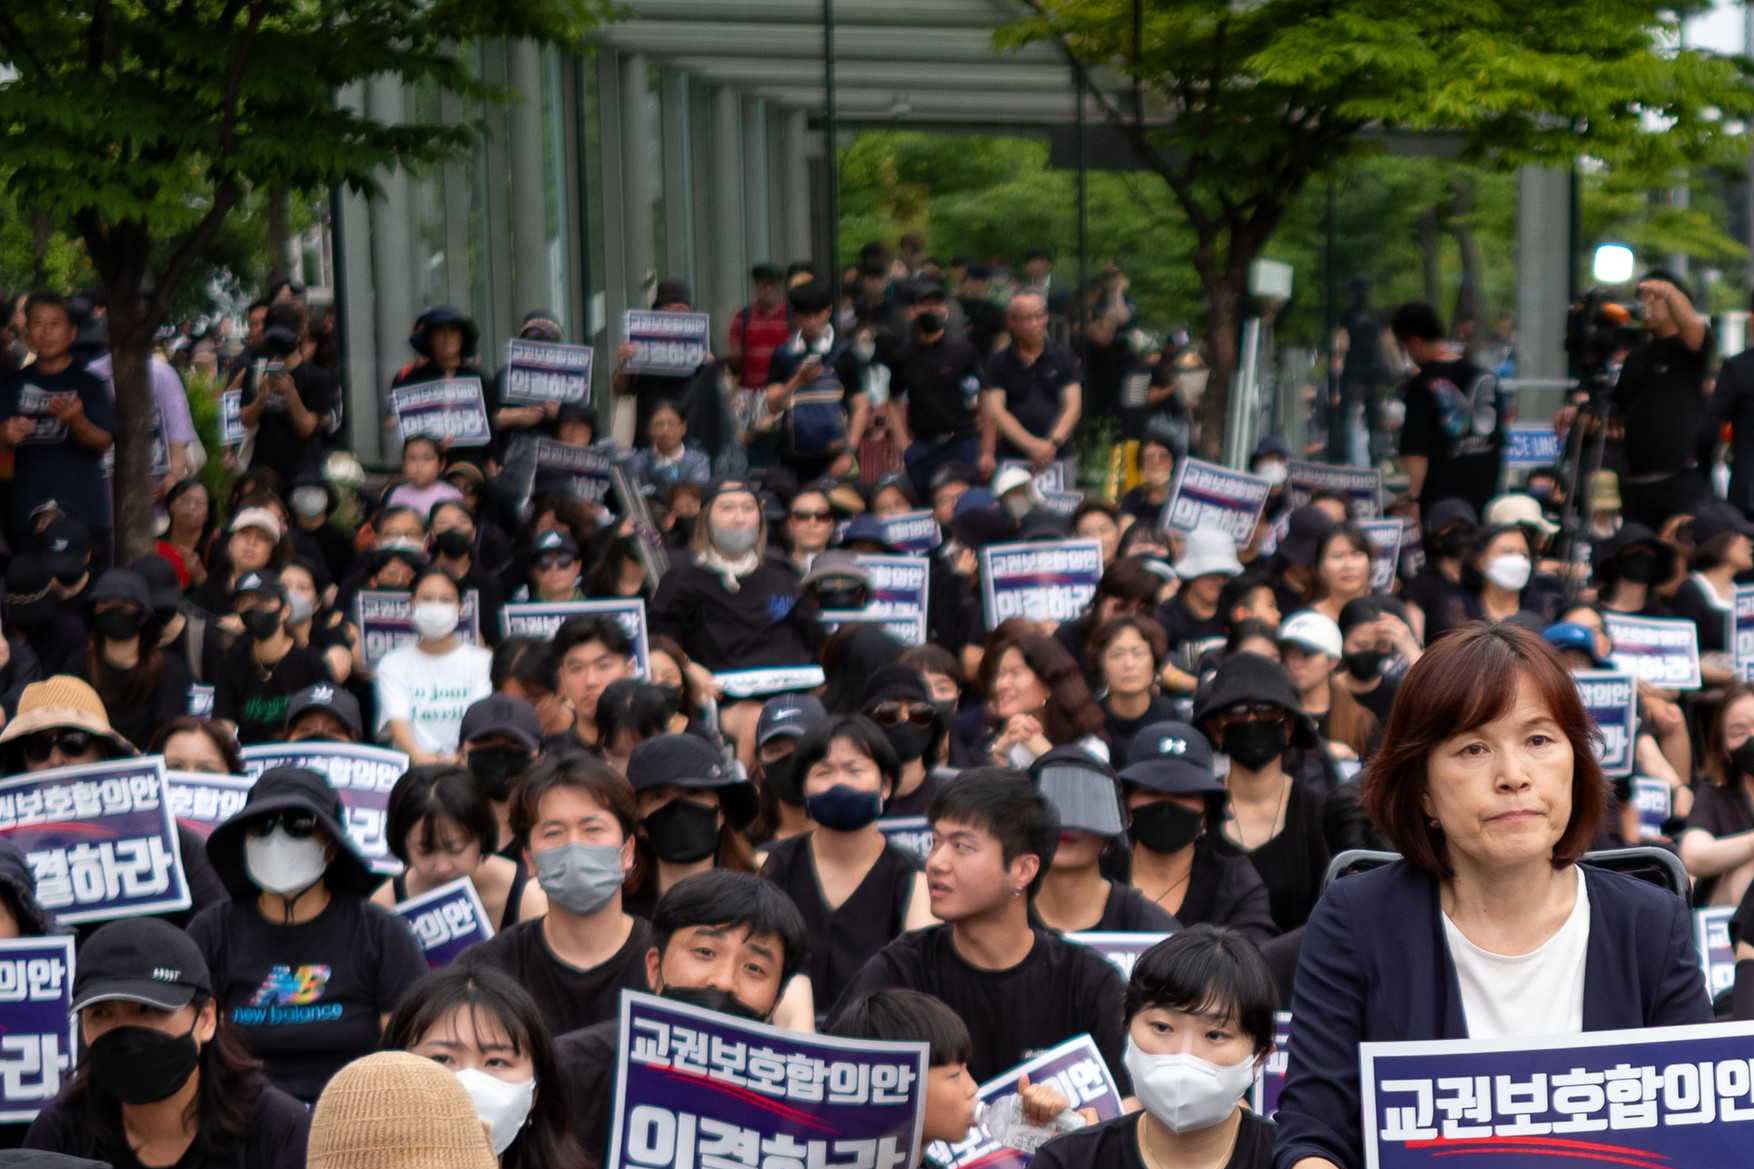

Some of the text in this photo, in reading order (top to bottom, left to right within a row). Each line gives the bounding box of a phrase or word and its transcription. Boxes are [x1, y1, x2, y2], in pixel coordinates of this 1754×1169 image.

[233, 1001, 343, 1025] new balance
[632, 1016, 916, 1105] 교권보호합의안
